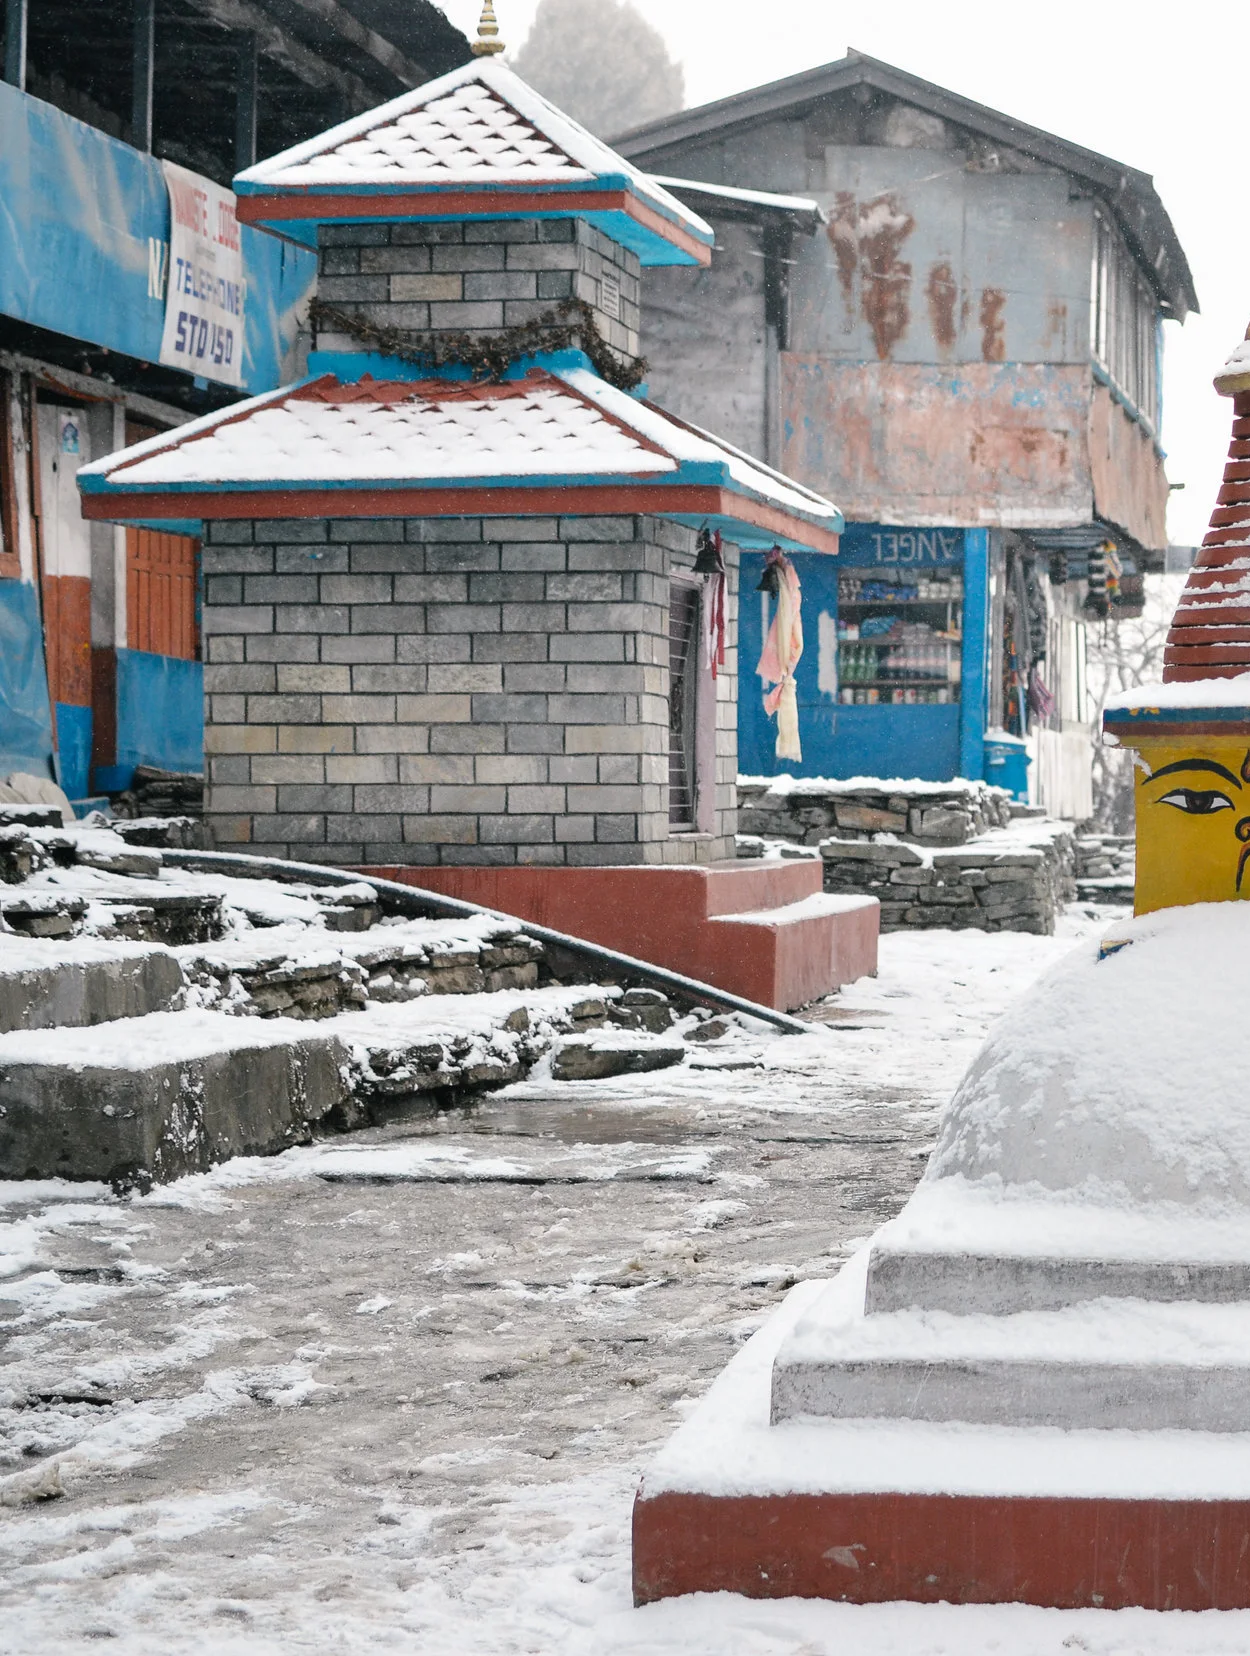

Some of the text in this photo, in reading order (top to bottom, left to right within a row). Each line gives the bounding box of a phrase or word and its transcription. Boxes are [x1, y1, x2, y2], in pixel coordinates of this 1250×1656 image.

[176, 257, 240, 316] TELEPHONE
[175, 311, 234, 365] STD ISD
[871, 530, 958, 563] ANGEL
